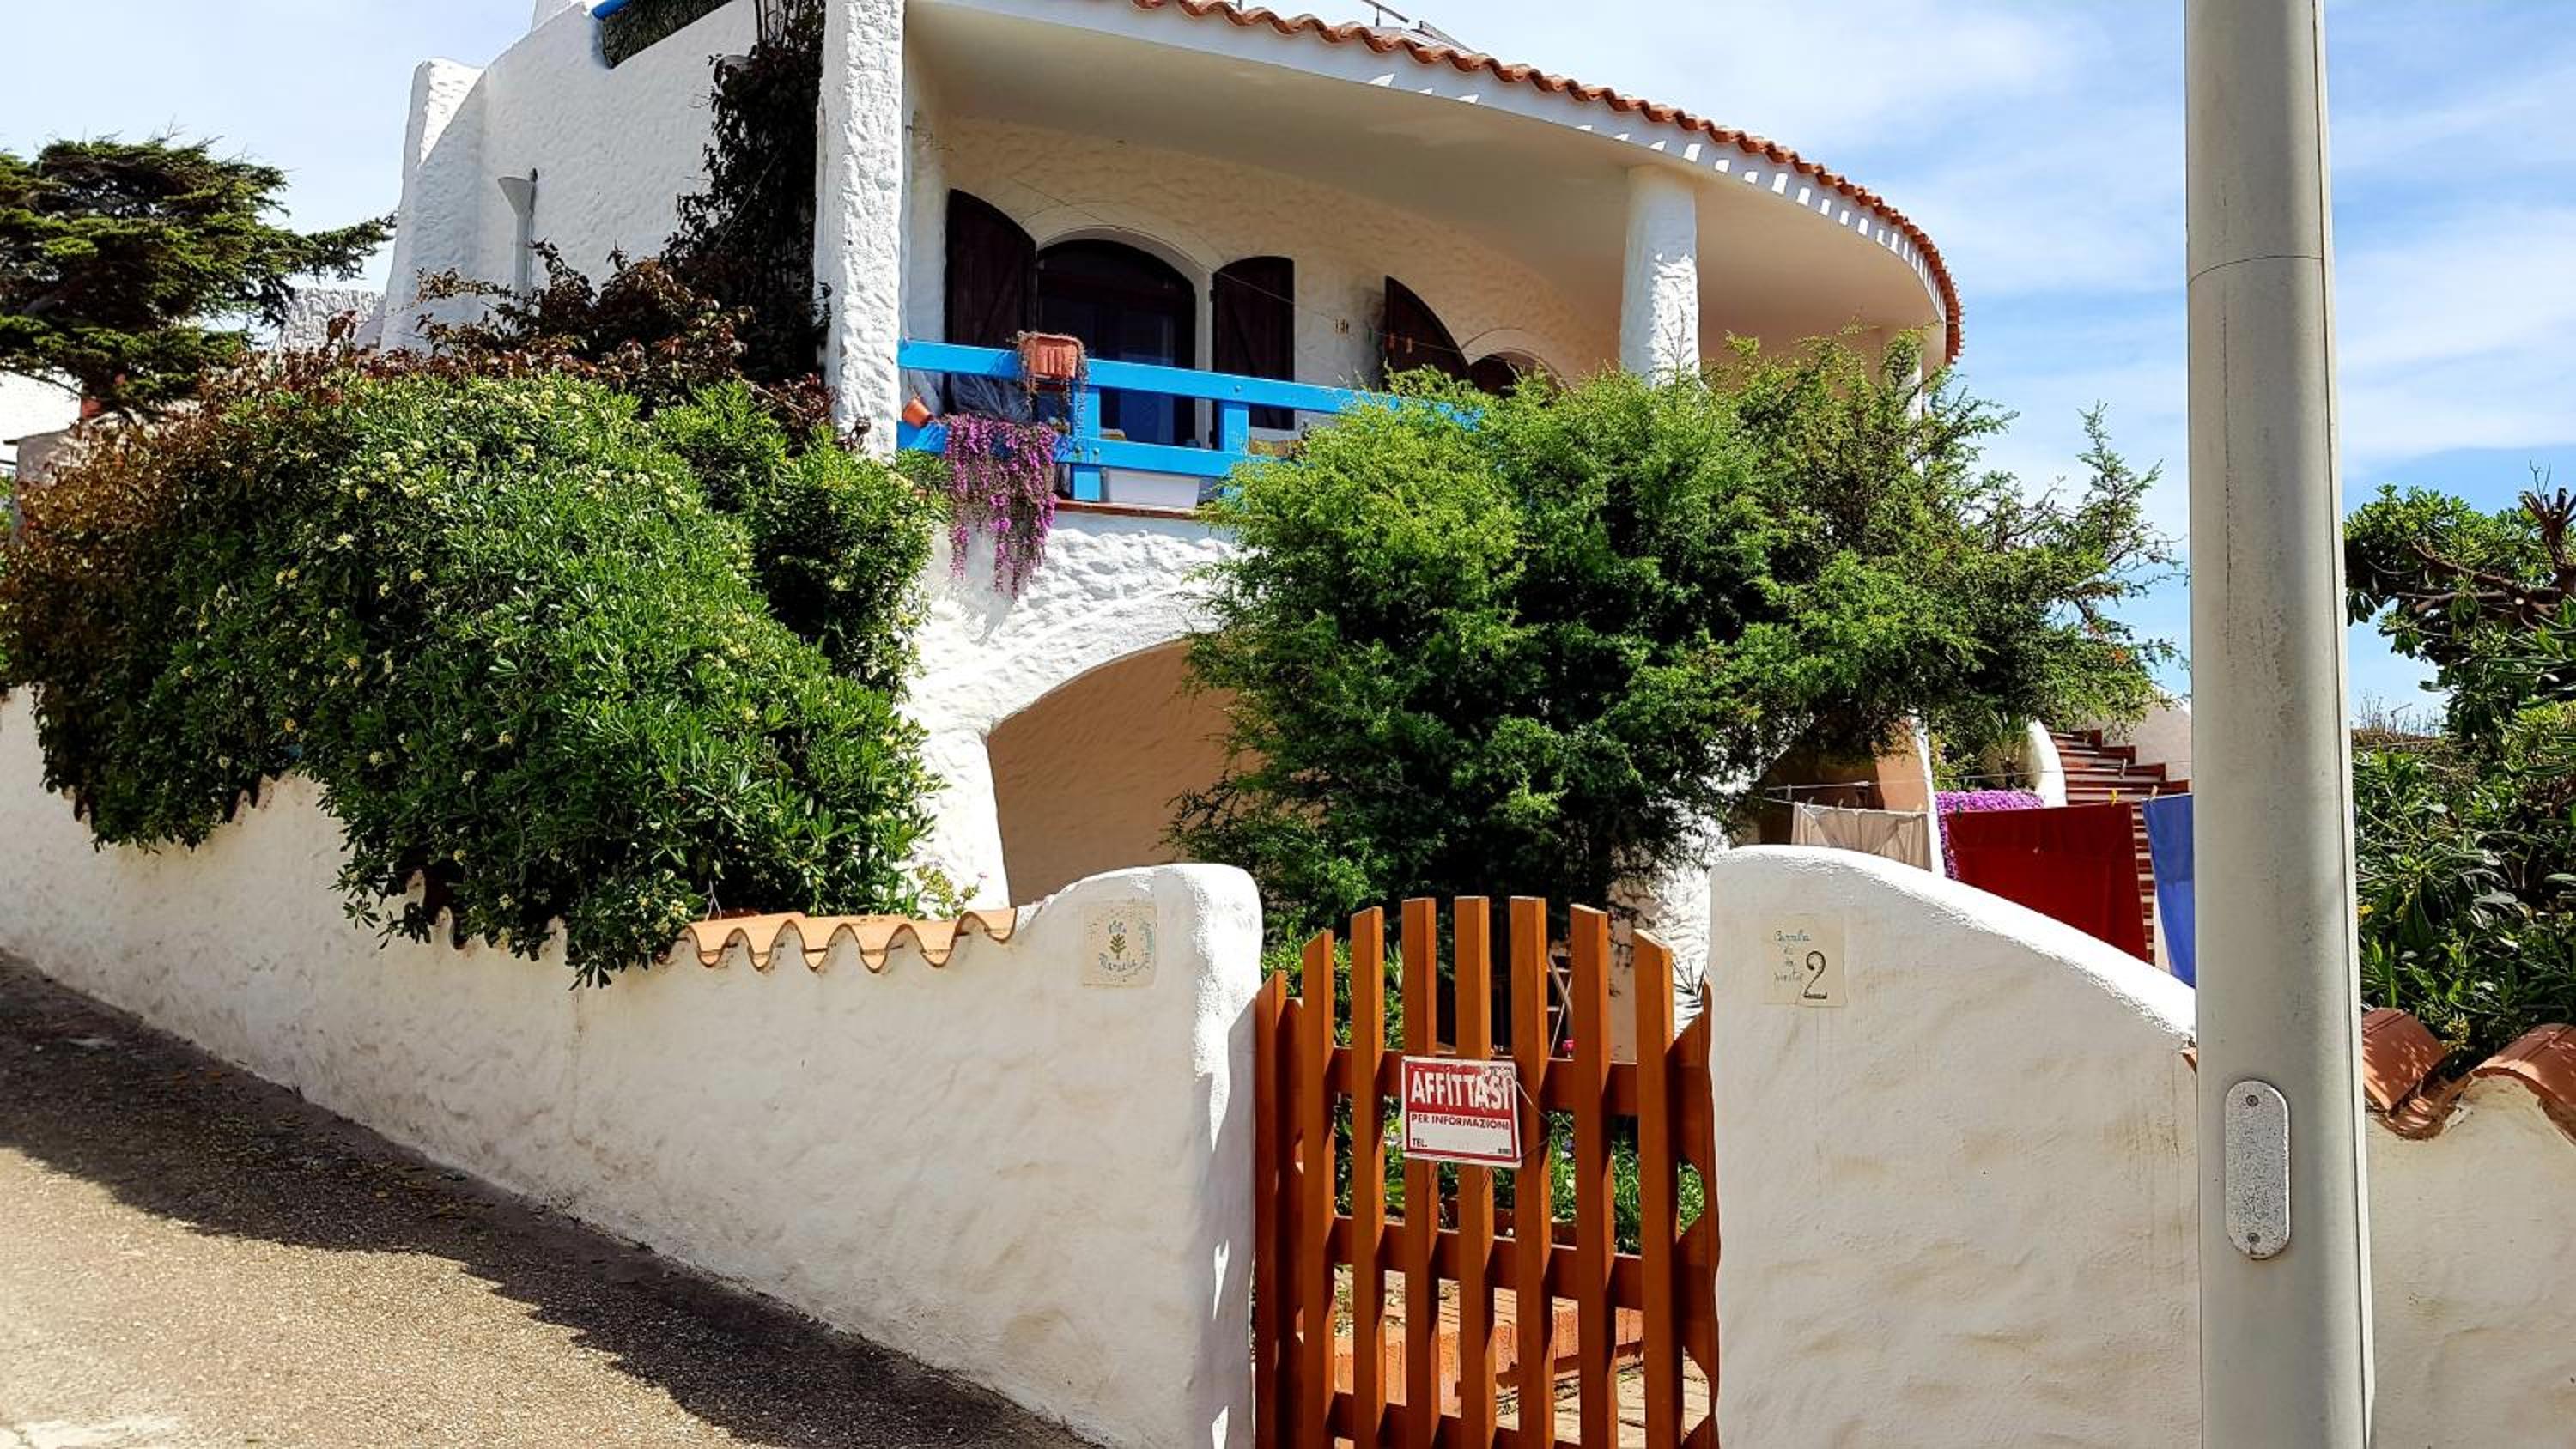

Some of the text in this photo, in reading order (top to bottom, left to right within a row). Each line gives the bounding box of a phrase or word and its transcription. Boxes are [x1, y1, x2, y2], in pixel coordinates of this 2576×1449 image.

[1803, 950, 1828, 1000] 2
[1411, 1071, 1510, 1109] AFFITTASI
[1411, 1114, 1429, 1123] PER
